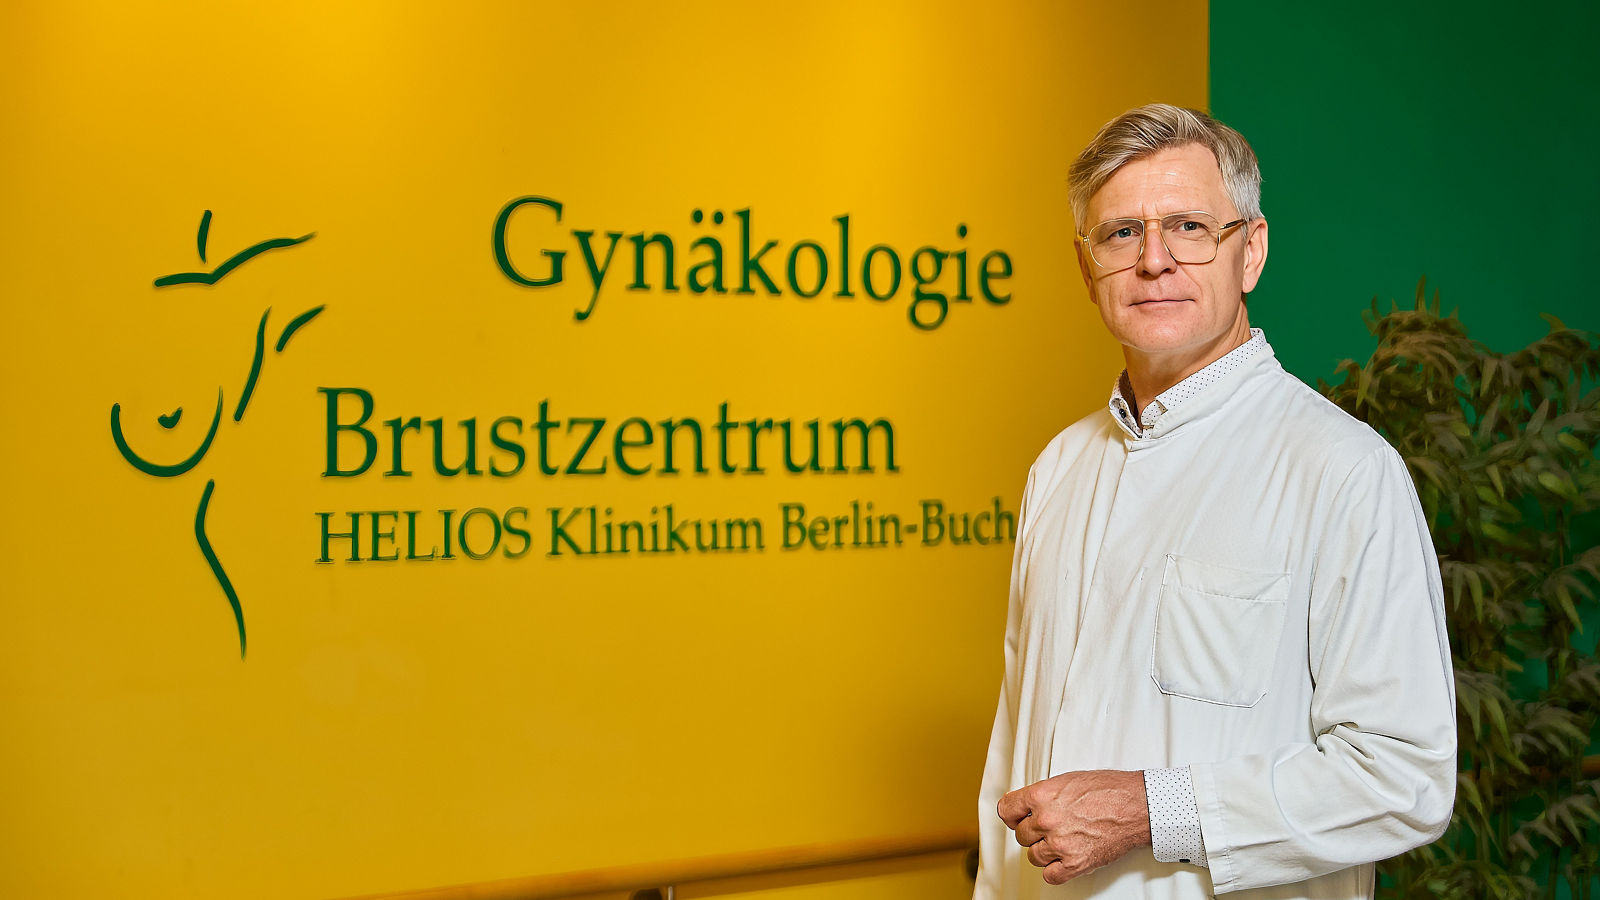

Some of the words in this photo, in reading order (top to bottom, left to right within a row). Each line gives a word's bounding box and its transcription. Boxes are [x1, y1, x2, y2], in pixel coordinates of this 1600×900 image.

[492, 194, 1014, 331] Gynäkologie
[317, 386, 900, 479] Brustzentrum
[315, 506, 532, 564] HELIOS
[548, 501, 765, 556] Klinikum
[780, 497, 1016, 550] Berlin-Buch
